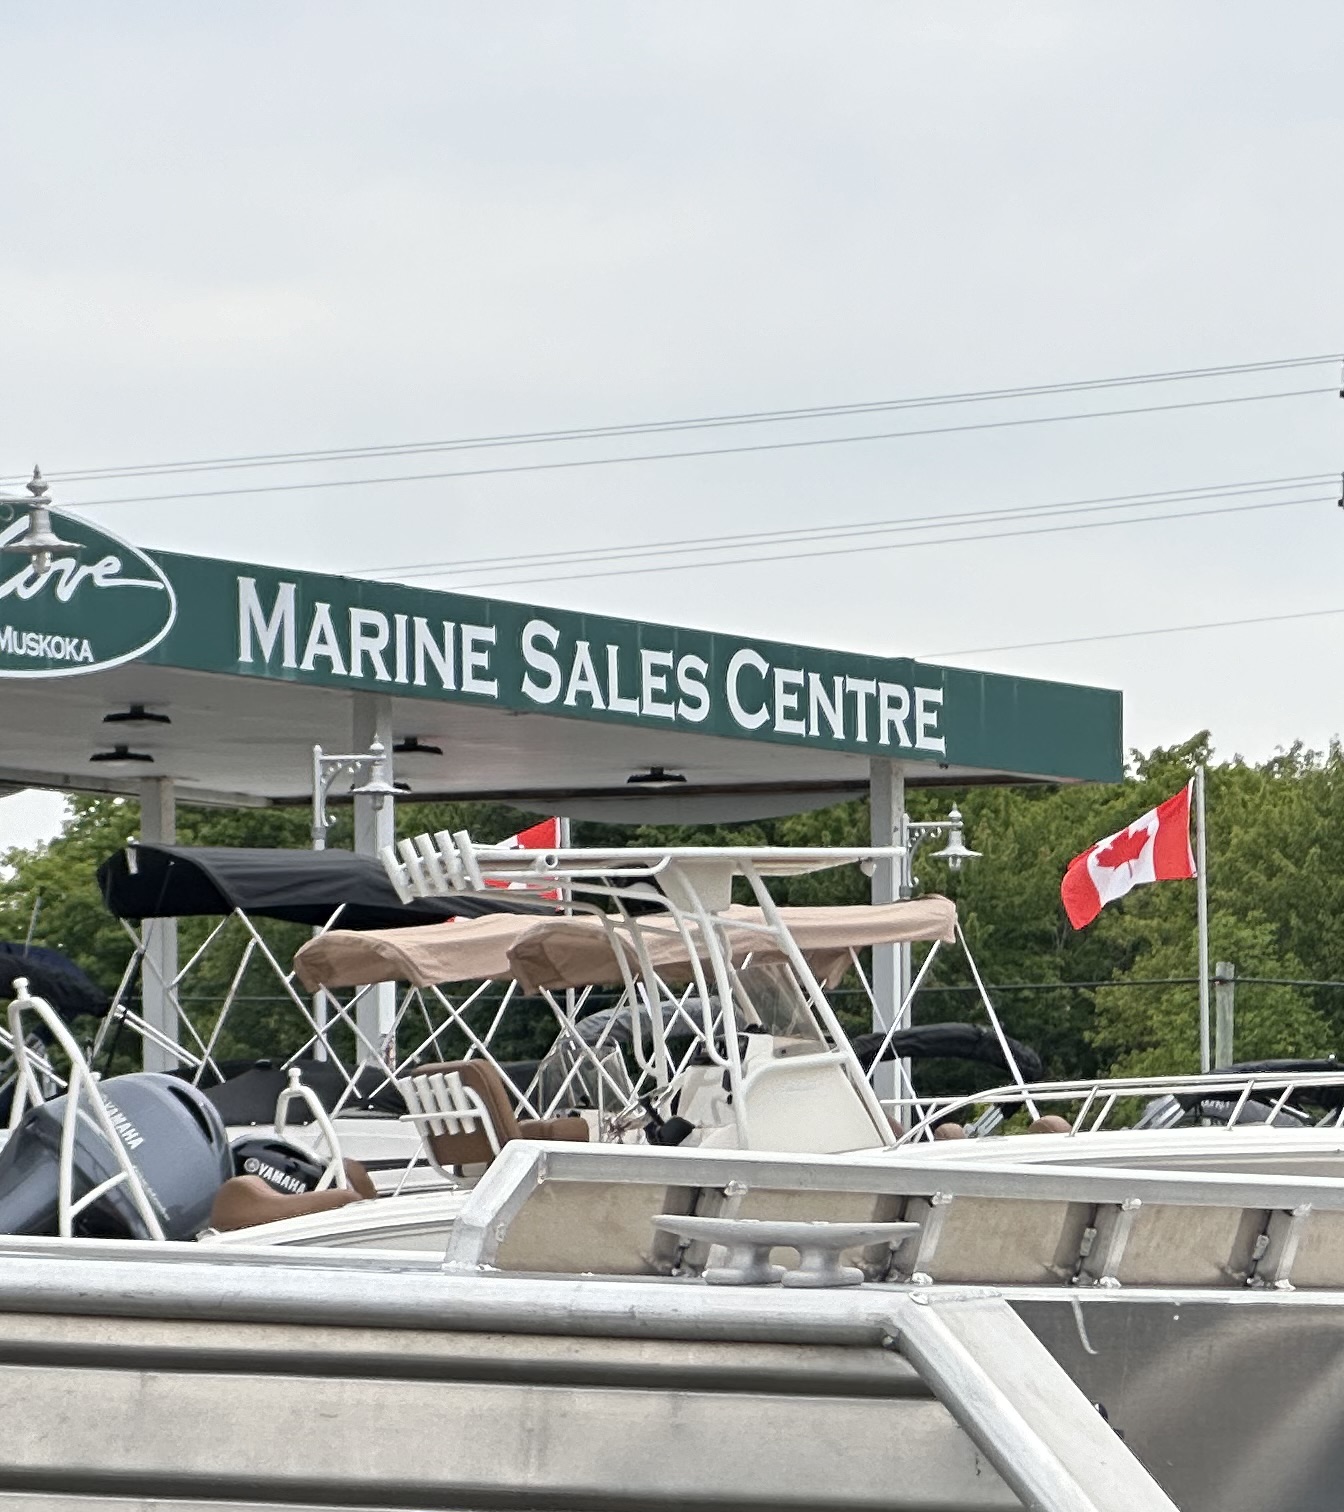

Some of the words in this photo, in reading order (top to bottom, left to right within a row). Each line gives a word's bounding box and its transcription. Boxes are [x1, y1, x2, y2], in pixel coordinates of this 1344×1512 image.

[0, 625, 95, 663] MUSKOKA
[237, 576, 499, 699] MARINE
[520, 618, 711, 723] SALES
[725, 647, 947, 757] CENTRE
[258, 1162, 308, 1195] YAMAHA
